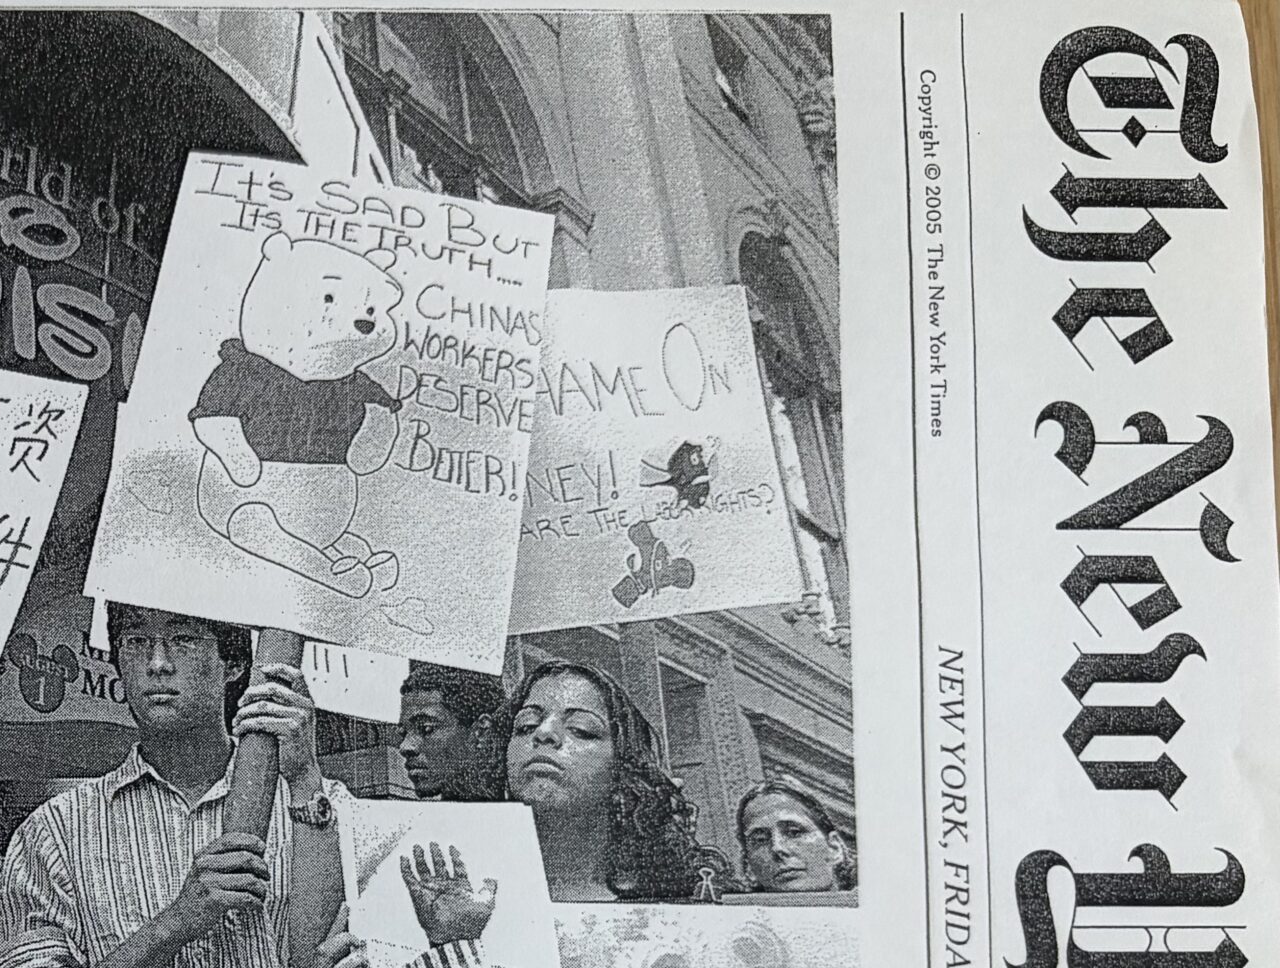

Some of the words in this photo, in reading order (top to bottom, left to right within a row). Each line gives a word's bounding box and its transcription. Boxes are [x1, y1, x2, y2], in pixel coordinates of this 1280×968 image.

[917, 69, 940, 159] Copyright
[296, 208, 361, 243] THE
[315, 180, 426, 229] SAD
[925, 185, 943, 235] 2005
[1022, 25, 1229, 372] The
[927, 243, 944, 281] The
[928, 285, 945, 328] New
[402, 320, 535, 391] WORKERS
[929, 330, 947, 375] York
[396, 364, 533, 434] DESERVE
[534, 360, 666, 418] HAME
[930, 378, 948, 438] Times
[393, 418, 519, 502] BETTER!
[519, 514, 581, 542] ARE
[586, 506, 630, 534] THE
[1033, 400, 1243, 812] New
[938, 644, 966, 735] NEW
[938, 741, 969, 849] YORK,
